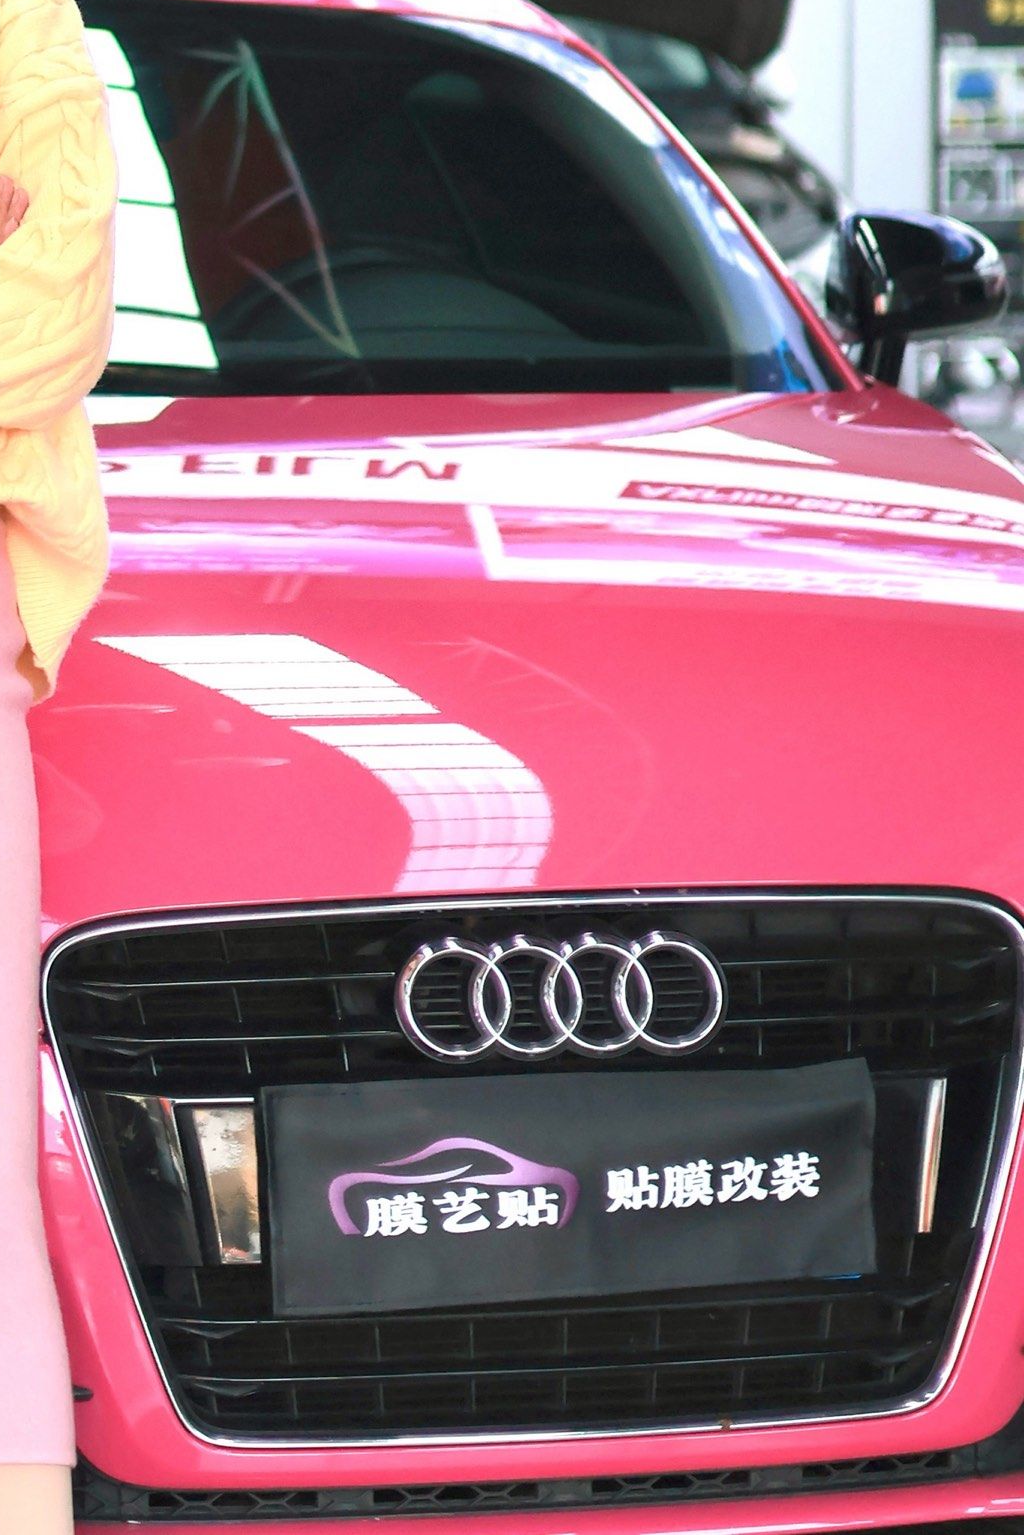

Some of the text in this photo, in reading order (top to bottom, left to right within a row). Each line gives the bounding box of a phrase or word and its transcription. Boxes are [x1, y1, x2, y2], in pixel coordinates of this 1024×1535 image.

[363, 1151, 821, 1238] 膜艺贴 贴膜改装
